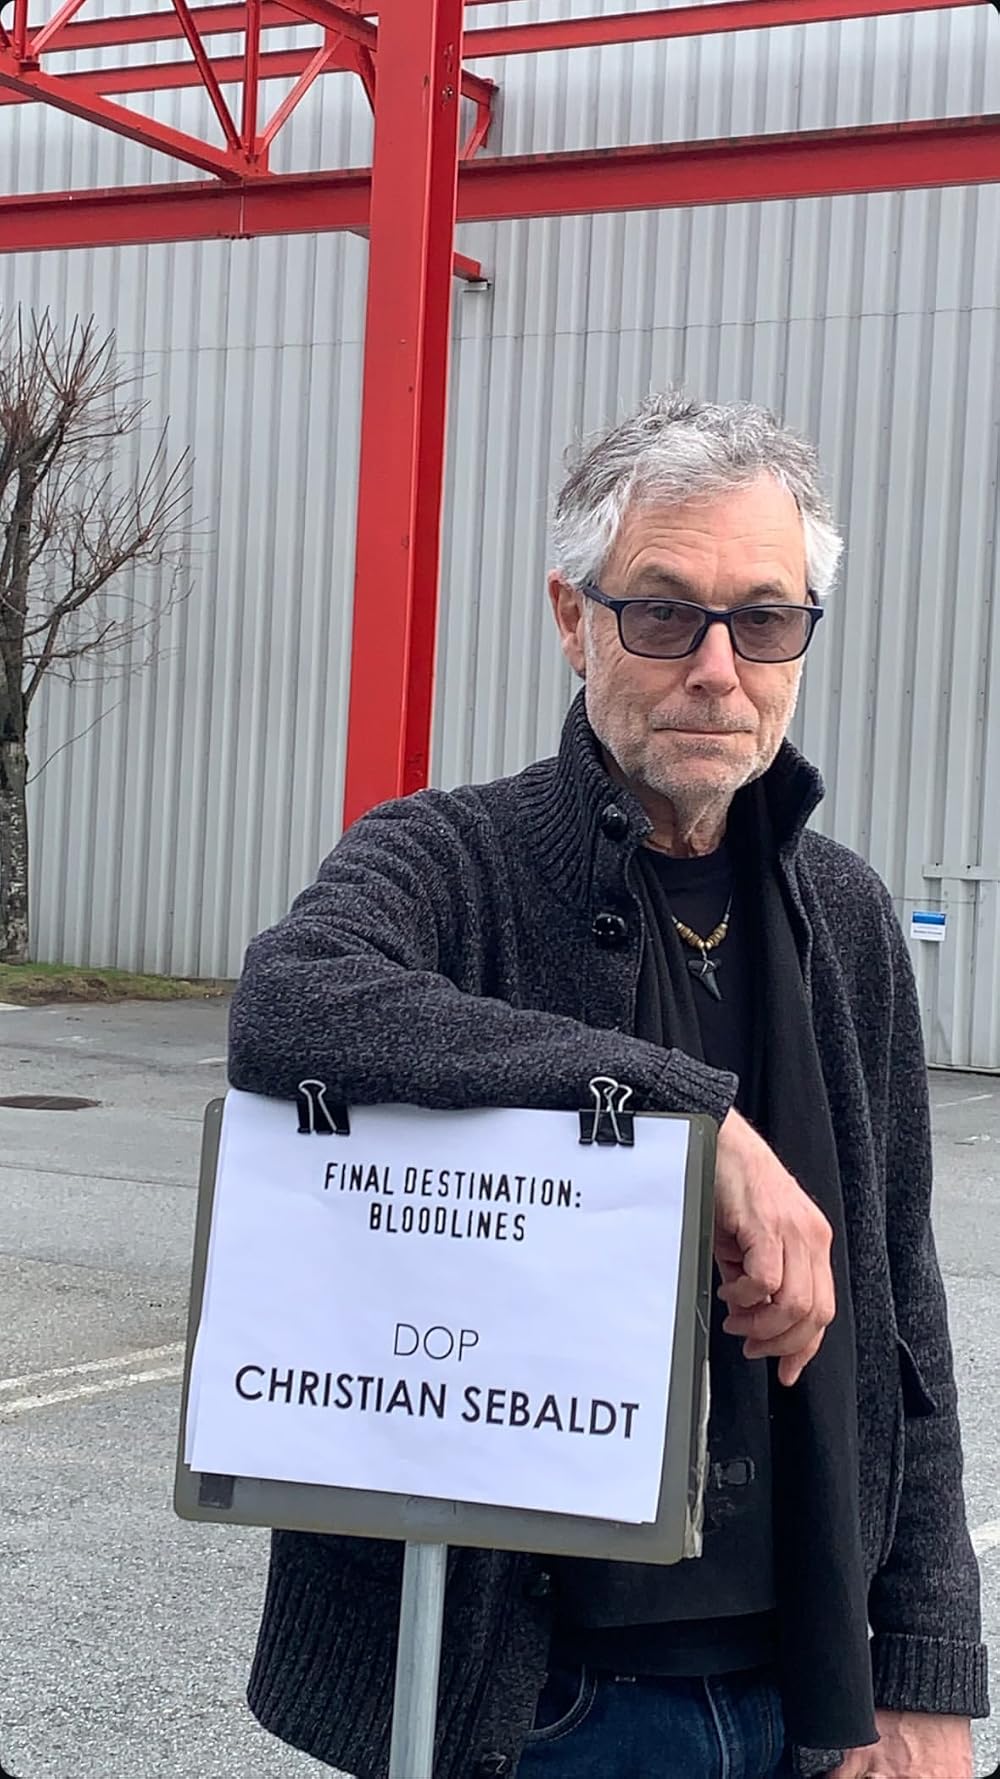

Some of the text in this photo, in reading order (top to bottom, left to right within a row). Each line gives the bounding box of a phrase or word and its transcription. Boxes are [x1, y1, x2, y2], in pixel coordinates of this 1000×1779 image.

[324, 1161, 583, 1210] FINAL DESTINATION:
[369, 1201, 527, 1242] BLOODLINES
[393, 1322, 480, 1362] DOP
[234, 1364, 641, 1439] CHRISTIAN SEBALDT
